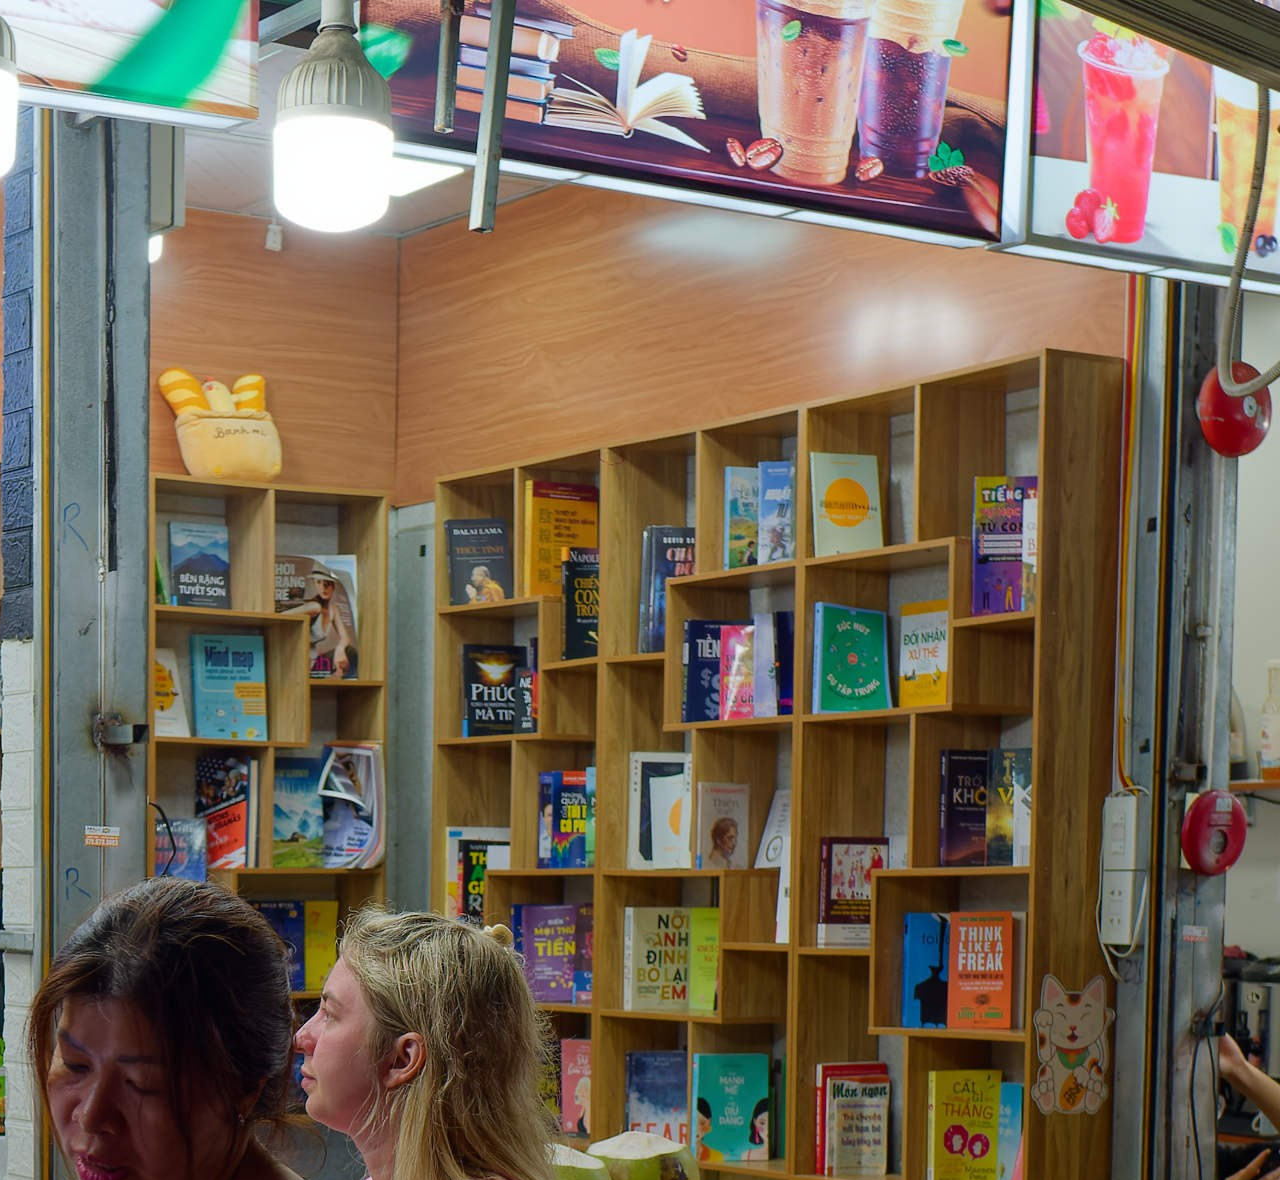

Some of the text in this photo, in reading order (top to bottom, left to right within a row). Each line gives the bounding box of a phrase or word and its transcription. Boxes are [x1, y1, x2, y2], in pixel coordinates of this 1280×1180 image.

[958, 926, 1003, 942] THINK
[958, 942, 1003, 953] LIKE A
[957, 953, 1004, 972] FREAK
[661, 984, 686, 1000] EM
